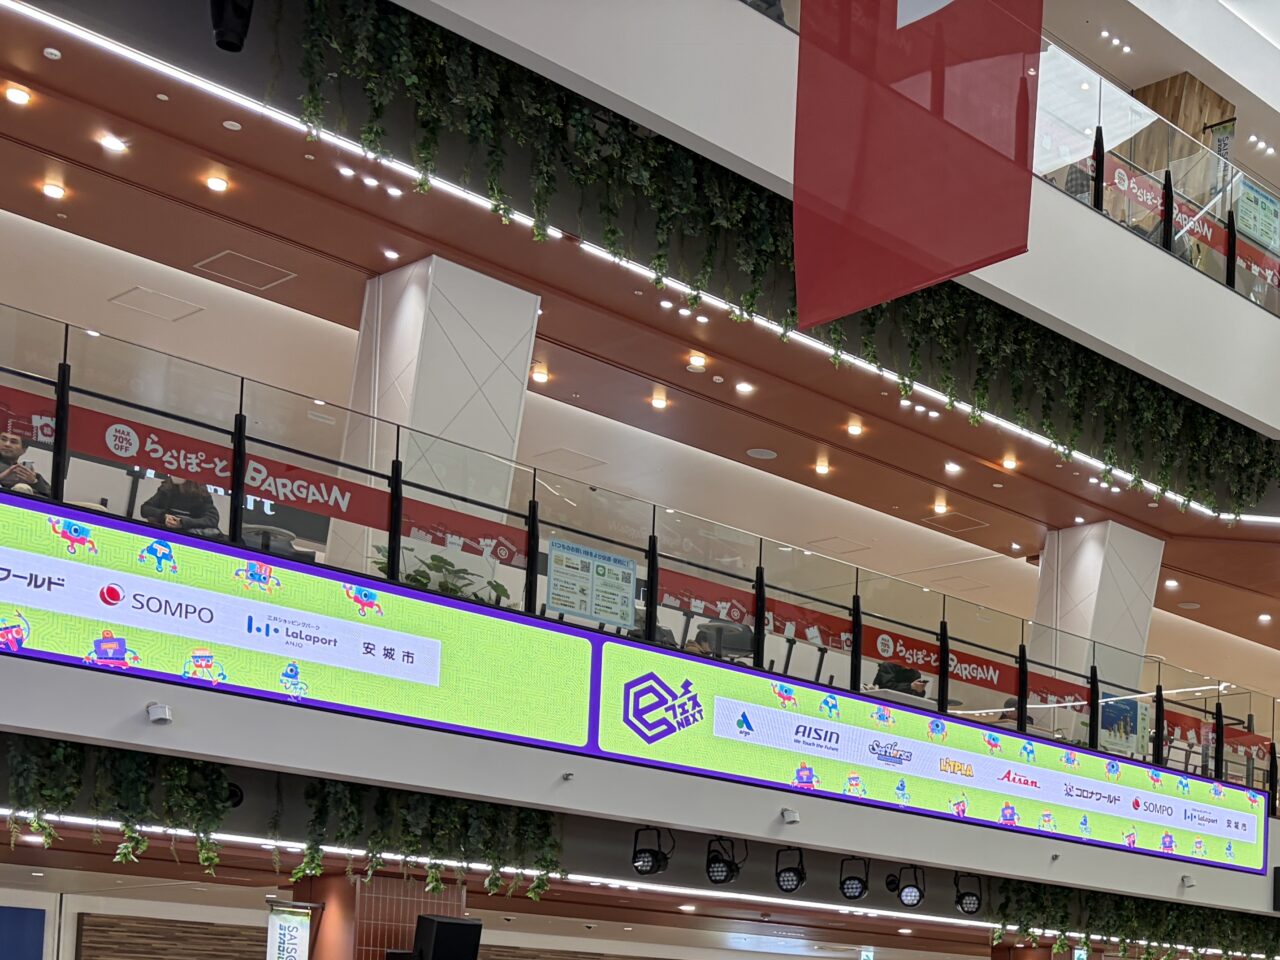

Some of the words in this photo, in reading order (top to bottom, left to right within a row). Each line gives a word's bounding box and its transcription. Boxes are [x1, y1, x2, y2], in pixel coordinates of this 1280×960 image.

[112, 434, 133, 447] 70%
[113, 444, 130, 453] OFF
[145, 433, 232, 477] ららぽーと
[244, 460, 351, 513] BARGAIN
[132, 593, 215, 625] SOMPO
[285, 627, 338, 647] LaLaport
[362, 641, 416, 665] 安城市
[896, 639, 939, 667] ららぽーと
[948, 652, 1000, 685] BARGAIN
[675, 708, 704, 732] NEXT
[794, 724, 840, 745] AISIN
[997, 769, 1041, 788] Aisan
[1074, 785, 1121, 805] コロナワールド
[1143, 801, 1174, 817] SOMPO
